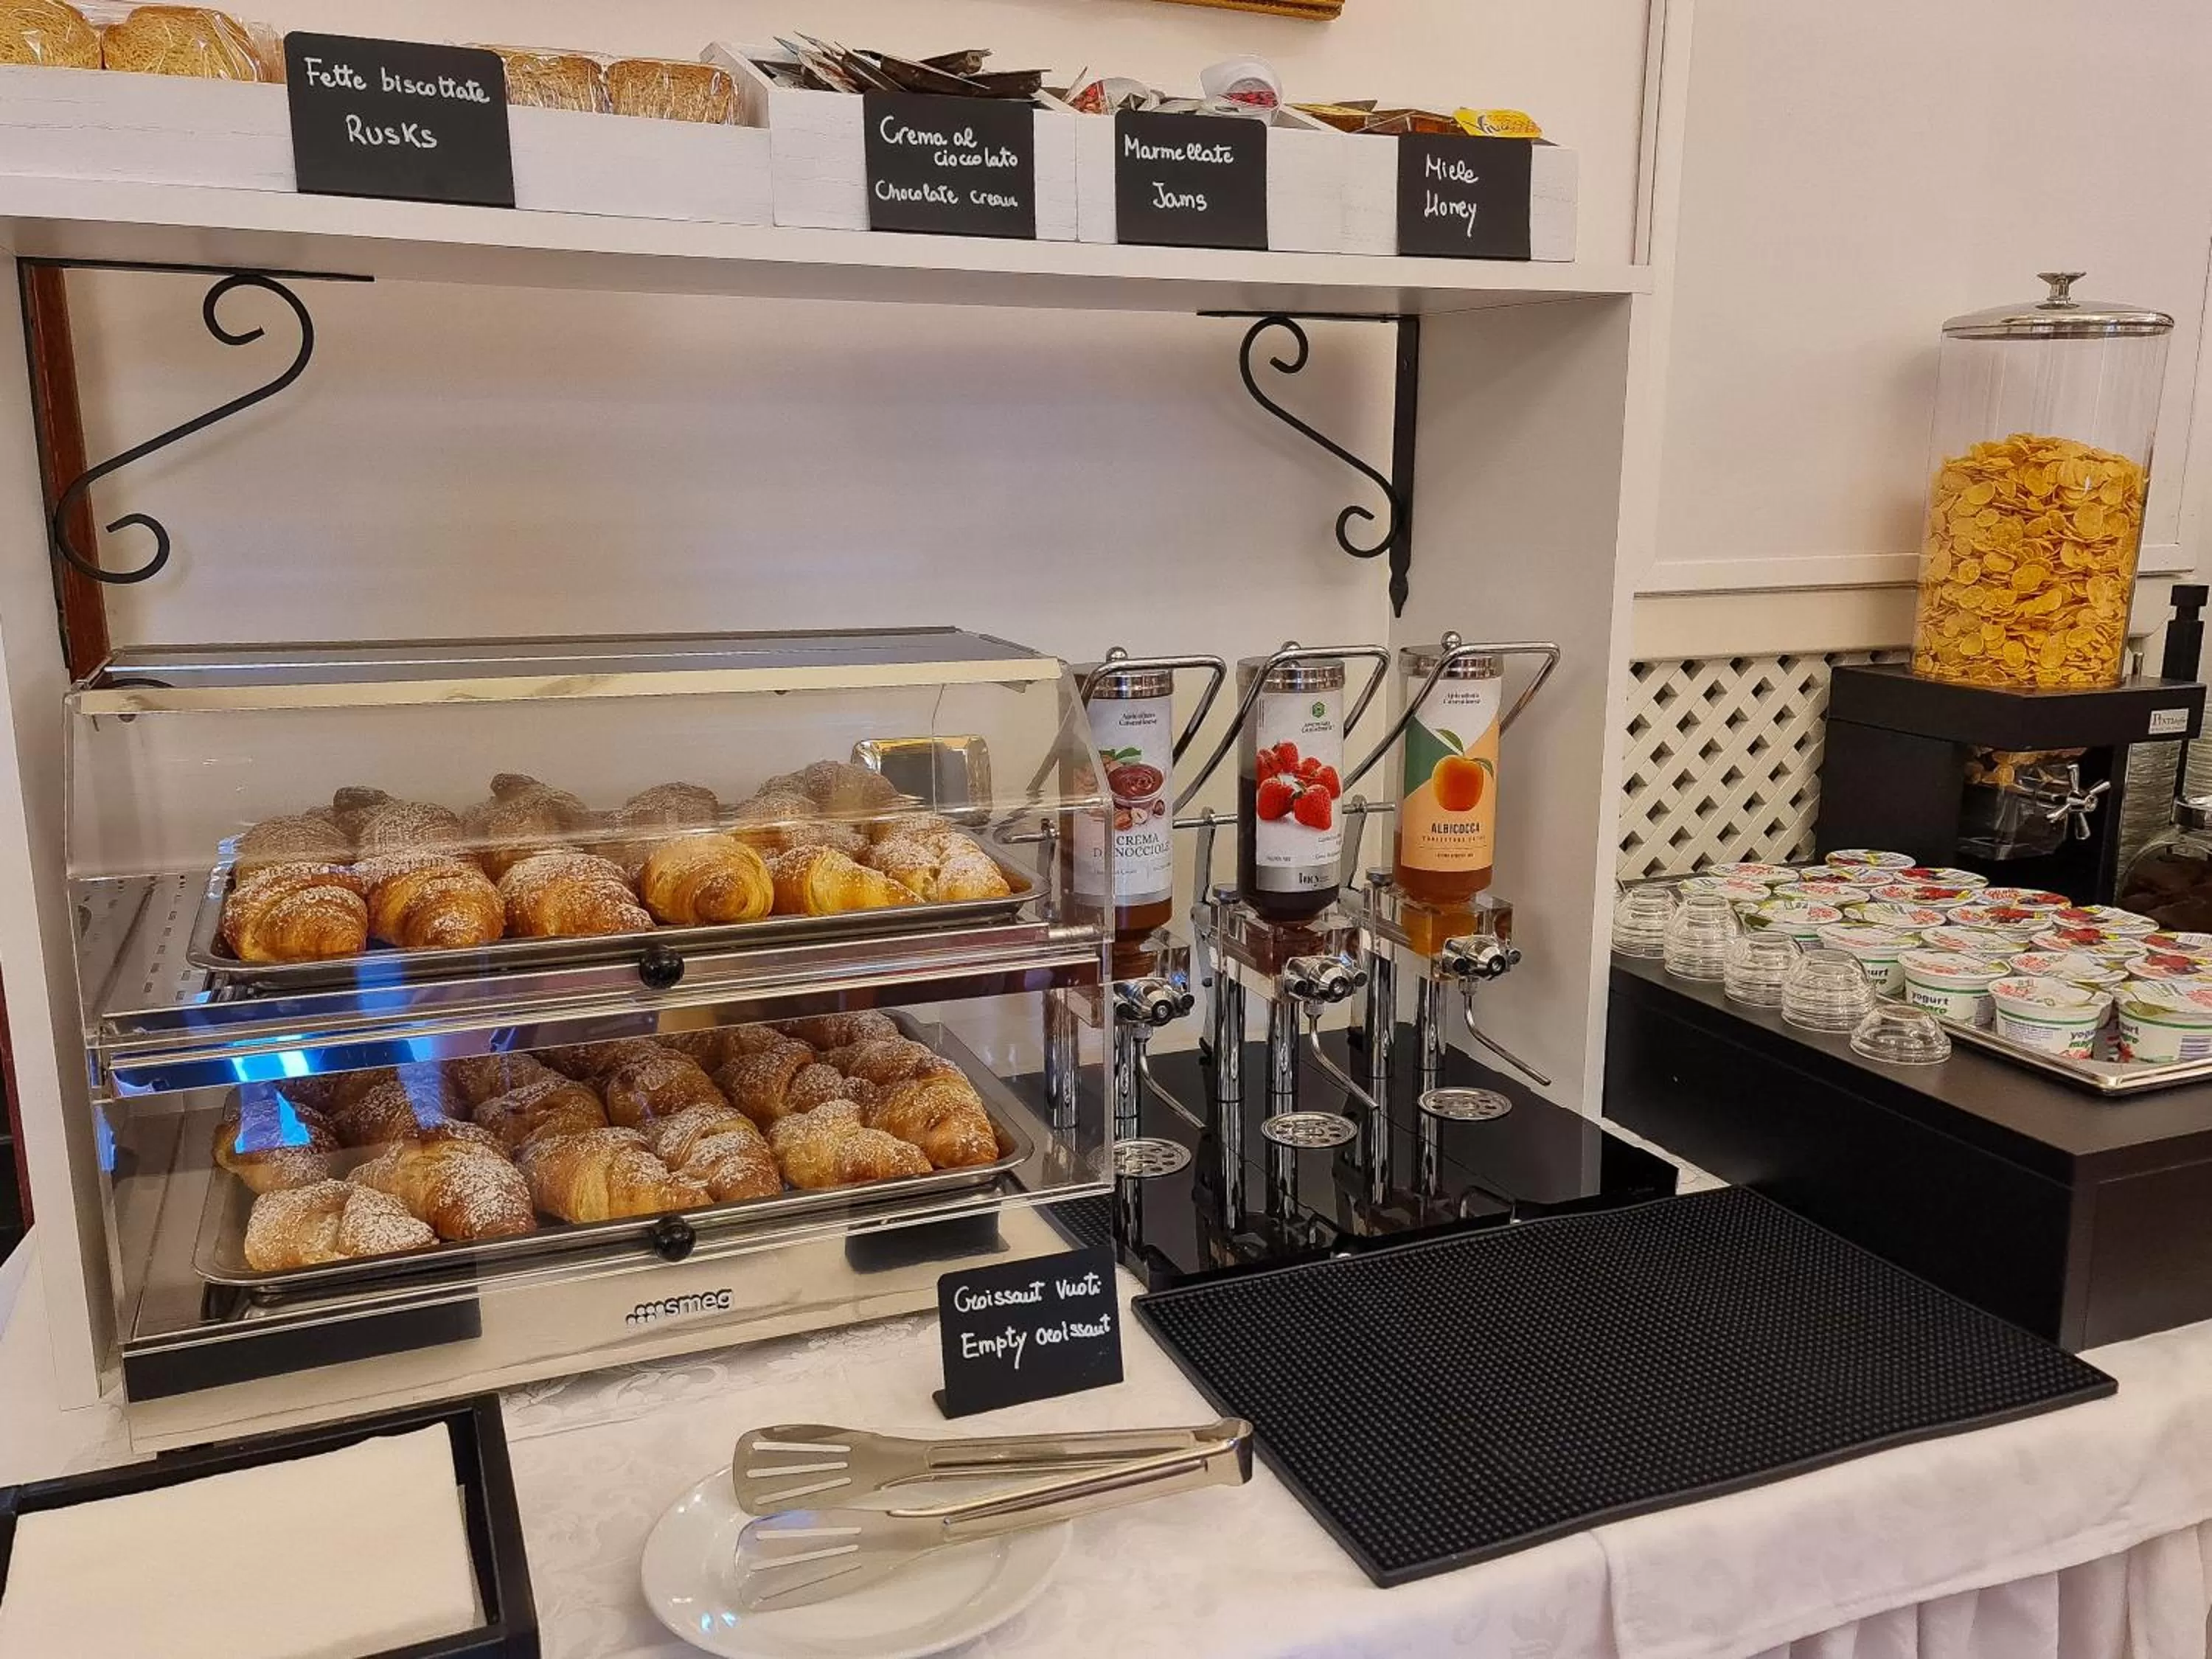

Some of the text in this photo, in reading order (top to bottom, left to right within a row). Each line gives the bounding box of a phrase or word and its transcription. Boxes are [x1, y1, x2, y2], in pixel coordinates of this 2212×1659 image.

[304, 57, 490, 103] Fette biscottate
[880, 115, 978, 148] Crema al
[933, 146, 1018, 167] cioccolato
[1124, 133, 1234, 164] Marmellate
[1425, 153, 1479, 184] Miele
[874, 179, 959, 204] Chocolate
[1152, 181, 1208, 212] Jams
[1424, 189, 1477, 238] Honey
[1116, 834, 1160, 846] CREMA
[1431, 822, 1480, 834] ALBICOCCA
[1911, 990, 1949, 1005] yogurt
[1055, 1272, 1102, 1300] Vuoti
[665, 1288, 732, 1314] smeg
[961, 1326, 1027, 1369] Empty
